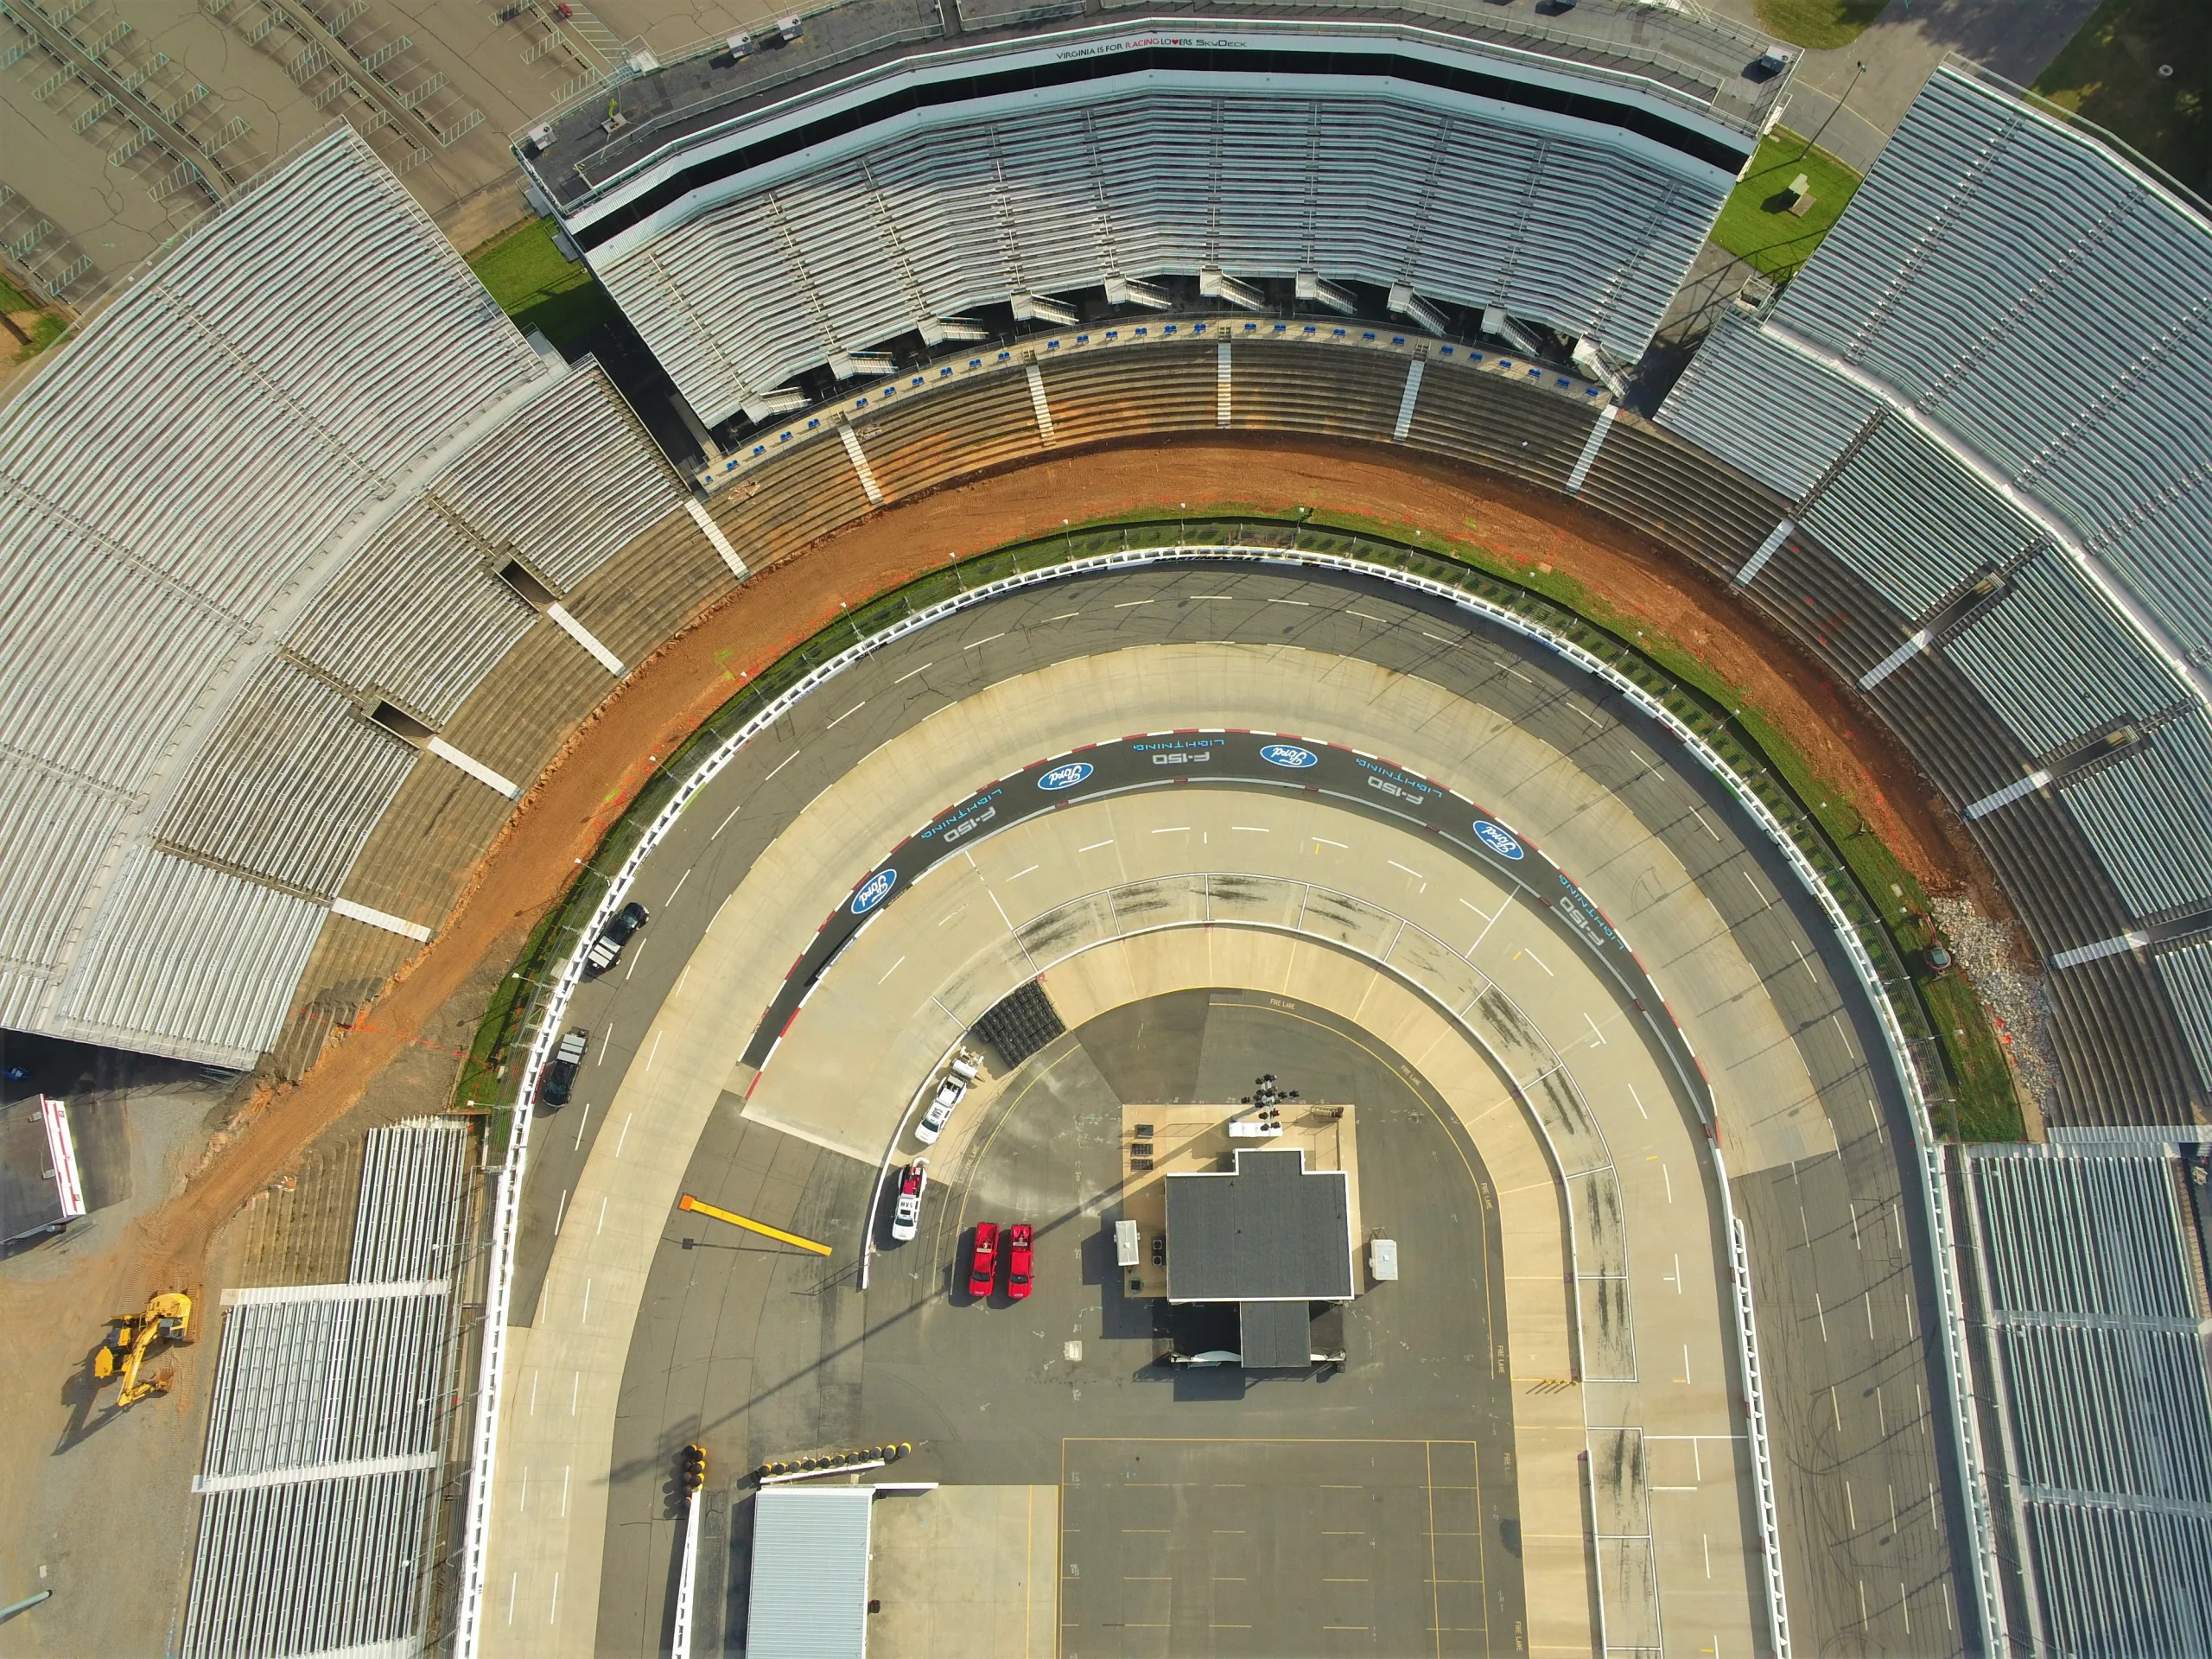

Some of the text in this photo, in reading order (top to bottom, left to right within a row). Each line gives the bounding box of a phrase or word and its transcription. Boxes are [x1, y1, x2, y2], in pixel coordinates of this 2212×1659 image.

[1056, 48, 1096, 60] VIRGINIA
[1105, 43, 1123, 53] FOR
[1125, 38, 1160, 49] RACING
[1133, 739, 1224, 752] LIGHTNING
[1152, 751, 1211, 765] F-150
[1271, 747, 1306, 766] Ford
[1048, 765, 1083, 786] Ford
[1356, 758, 1442, 798] LIGHTNING
[1367, 775, 1424, 805] F-150
[920, 788, 1002, 839] LIGHTNING
[943, 805, 996, 842] F-150
[1482, 825, 1516, 855] Ford
[858, 874, 888, 906] Ford
[1558, 874, 1624, 950] LIGHTNING
[1559, 896, 1605, 946] F-150
